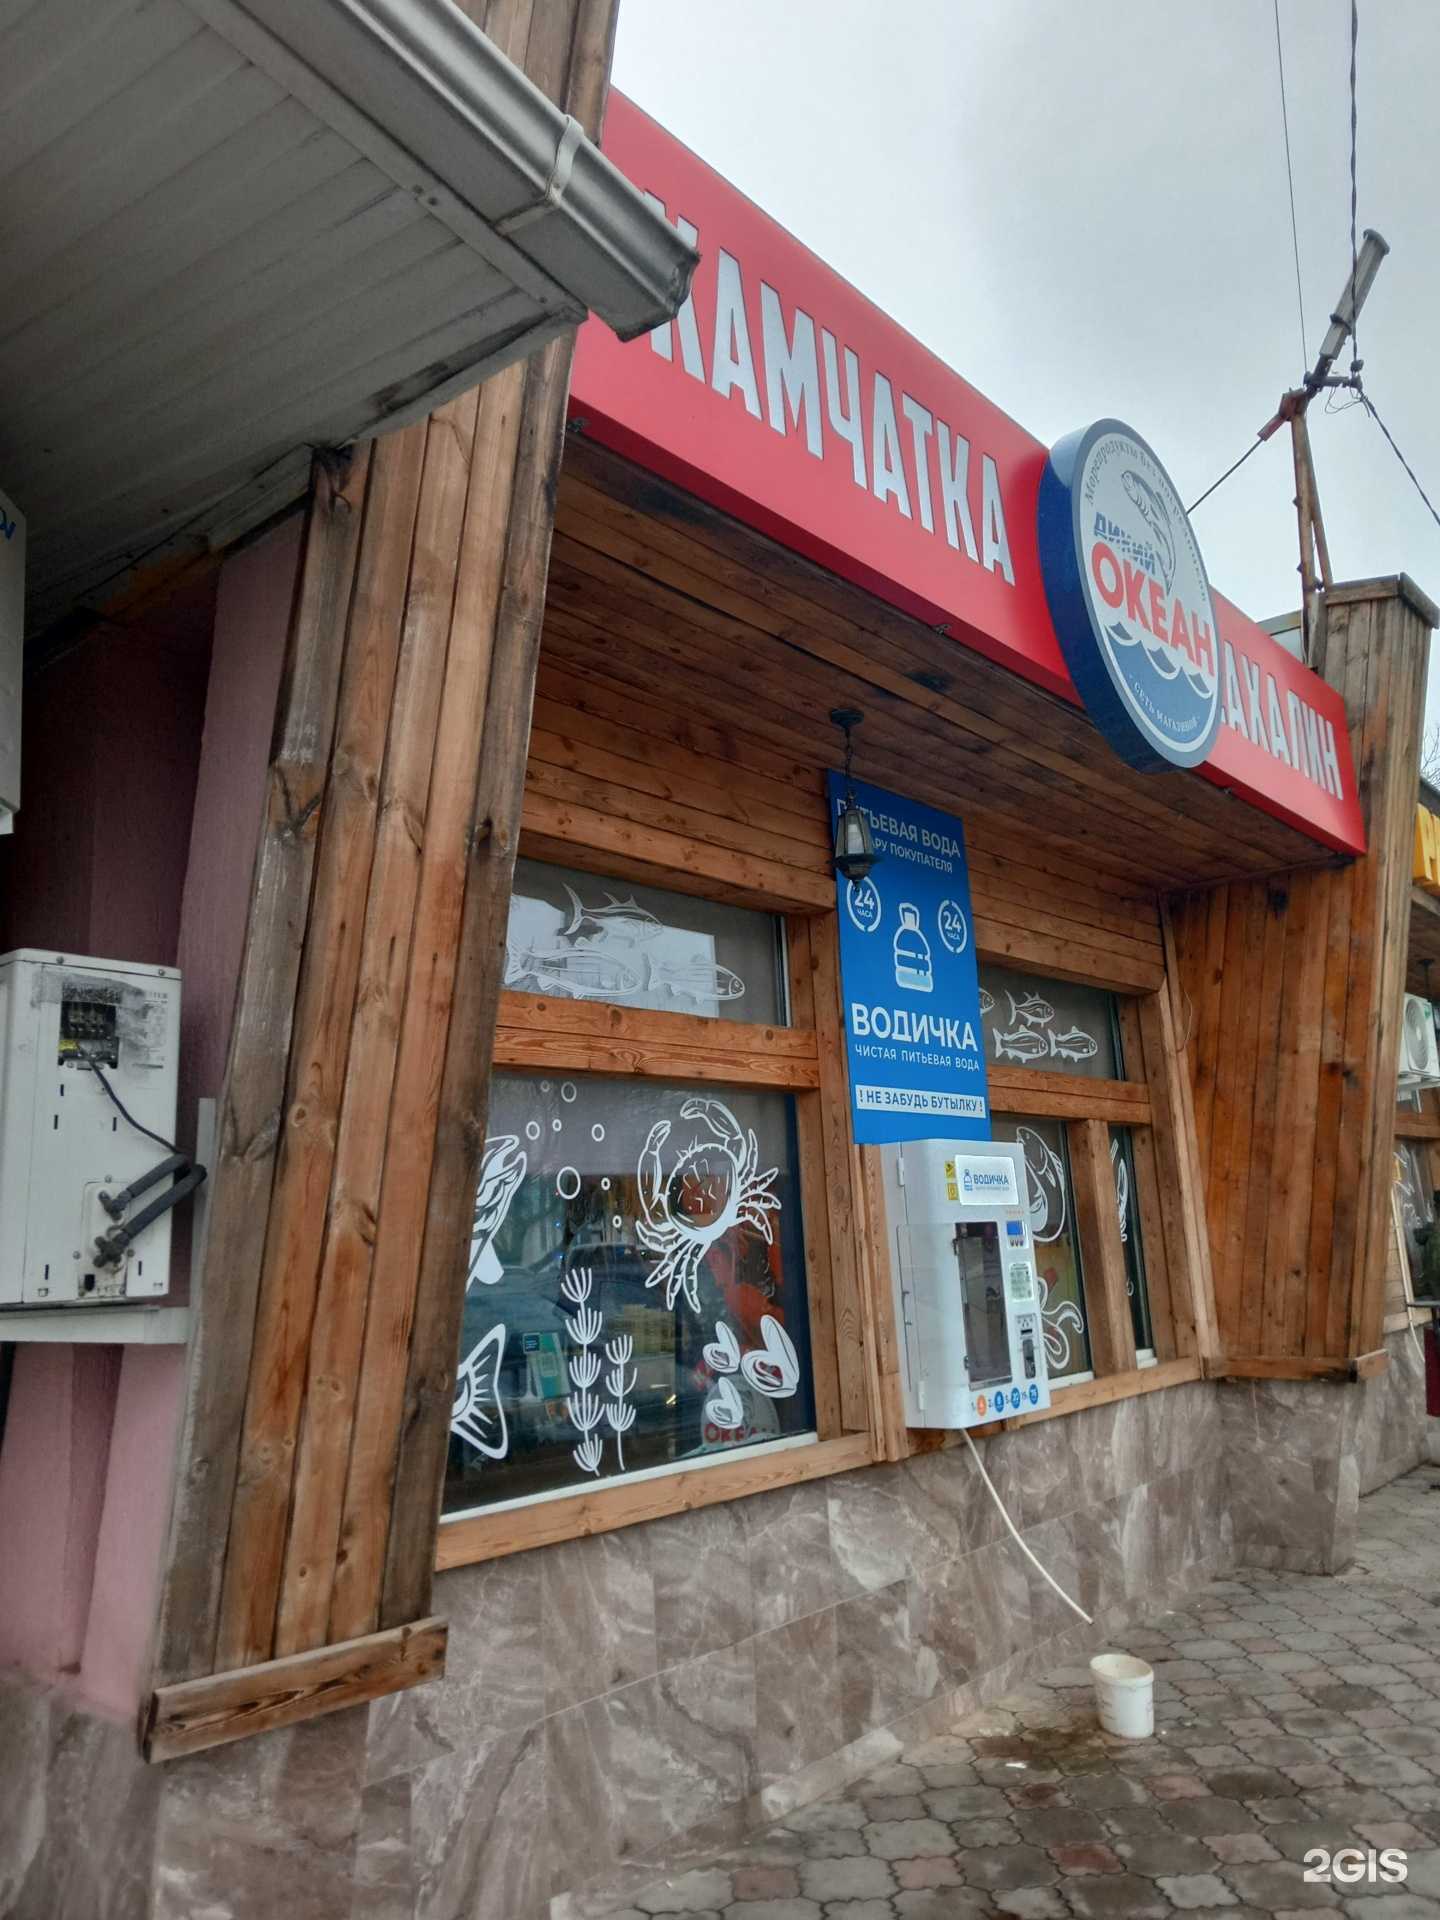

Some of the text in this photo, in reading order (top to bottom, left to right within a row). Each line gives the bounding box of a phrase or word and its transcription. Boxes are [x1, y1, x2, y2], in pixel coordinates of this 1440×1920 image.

[1091, 541, 1215, 677] ОКЕАН
[1222, 640, 1343, 801] АХАЛИН
[890, 842, 953, 874] ПОКУПАТЕЛЯ
[921, 828, 961, 859] ВОДА
[854, 886, 875, 910] 24
[943, 911, 962, 932] 24
[851, 1002, 979, 1053] ВОДИЧКА
[855, 1043, 980, 1073] ЧИСТАЯ ПИТЬЕВАЯ ВОДА
[866, 1090, 882, 1105] НЕ
[884, 1091, 929, 1110] ЗАБУДЬ
[931, 1095, 977, 1113] БУТЫЛКУ
[973, 1173, 1010, 1185] ВОДИЧКА
